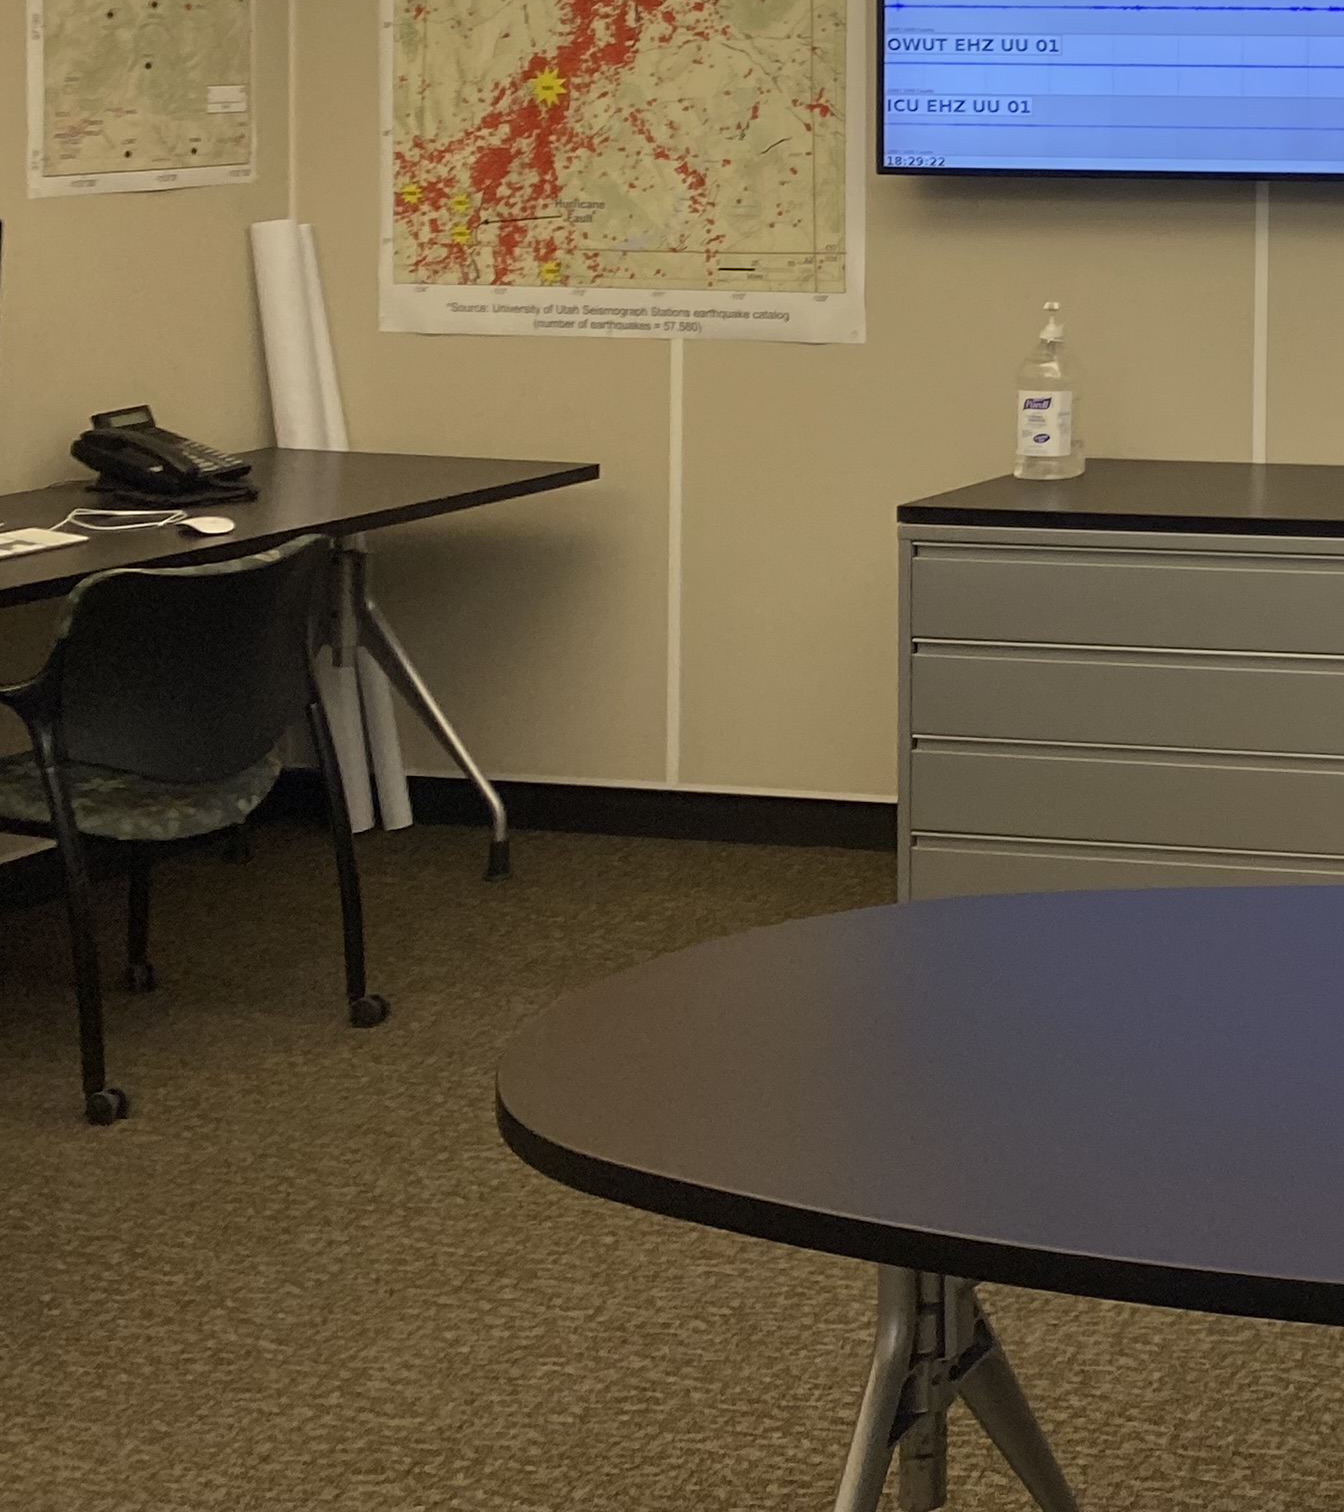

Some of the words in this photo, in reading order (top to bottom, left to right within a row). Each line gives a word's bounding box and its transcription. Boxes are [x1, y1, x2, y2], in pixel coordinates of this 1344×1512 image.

[888, 38, 948, 51] OWUT
[955, 39, 994, 52] EHZ
[1001, 39, 1028, 52] UU
[1036, 39, 1059, 52] 01
[887, 100, 919, 112] ICU
[927, 100, 966, 113] EHZ
[973, 100, 1000, 113] UU
[1007, 100, 1031, 113] 01
[887, 157, 946, 167] 18:29:22
[493, 304, 539, 316] University
[543, 304, 552, 314] of
[556, 305, 579, 314] Utah
[583, 305, 648, 318] Seismograph
[651, 307, 690, 317] Stations
[693, 309, 750, 320] earthquake
[752, 311, 789, 322] catalog
[534, 320, 575, 329] (number
[578, 319, 588, 329] of
[591, 321, 651, 332] earthquakes
